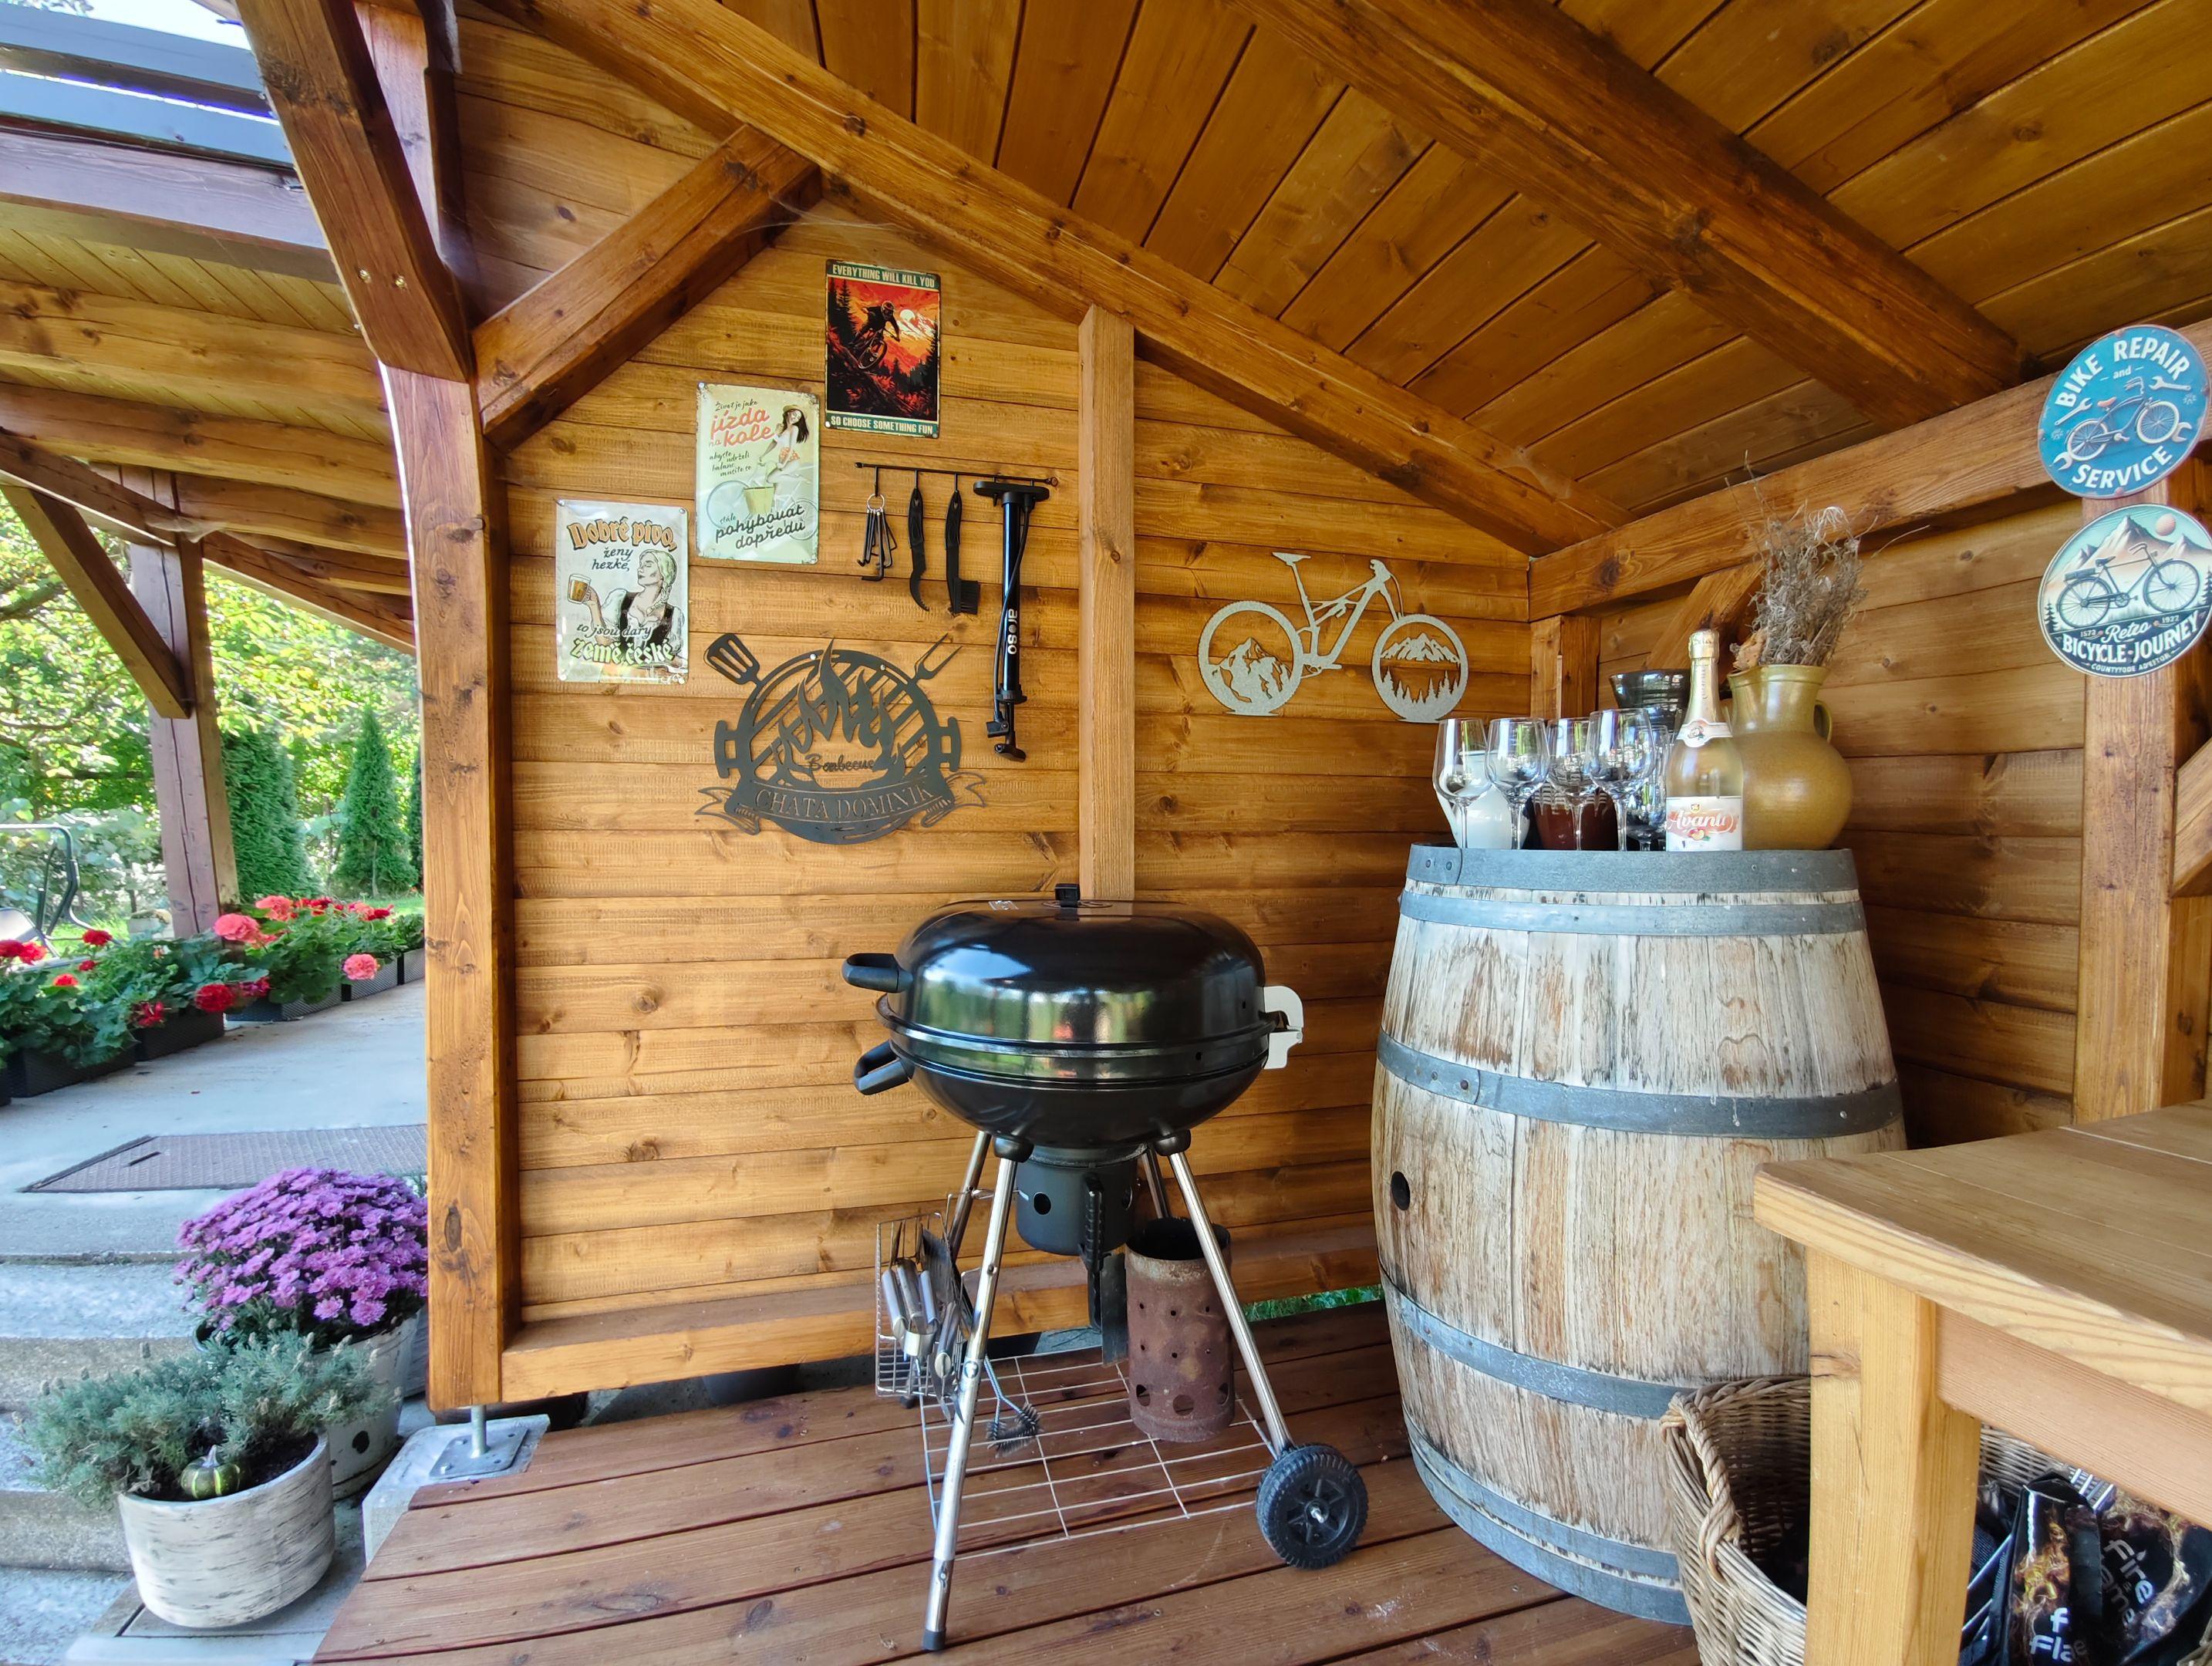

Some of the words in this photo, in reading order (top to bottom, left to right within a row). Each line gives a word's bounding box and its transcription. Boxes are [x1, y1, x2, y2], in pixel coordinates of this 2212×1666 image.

[832, 264, 881, 281] EVERYTHING
[882, 271, 901, 283] WILL
[902, 274, 918, 286] KILL
[919, 276, 935, 288] YOU
[2055, 353, 2104, 407] BIKE
[2113, 336, 2190, 381] REPAIR
[2113, 366, 2132, 379] and
[710, 407, 770, 440] jízda
[723, 423, 774, 447] kole
[830, 416, 841, 426] SO
[842, 416, 872, 429] CHOOSE
[873, 420, 917, 433] SOMETHING
[918, 424, 933, 434] FUN
[2072, 445, 2173, 489] SERVICE
[567, 516, 629, 551] Dobré
[716, 504, 804, 544] pohybovat
[592, 559, 630, 572] hezké,
[603, 547, 633, 561] ženy
[576, 624, 589, 632] to
[585, 625, 618, 638] jsou
[621, 625, 652, 639] dary
[2133, 610, 2198, 663] JOURNEY
[754, 788, 828, 818] CHATA
[837, 784, 933, 818] DOMINIK
